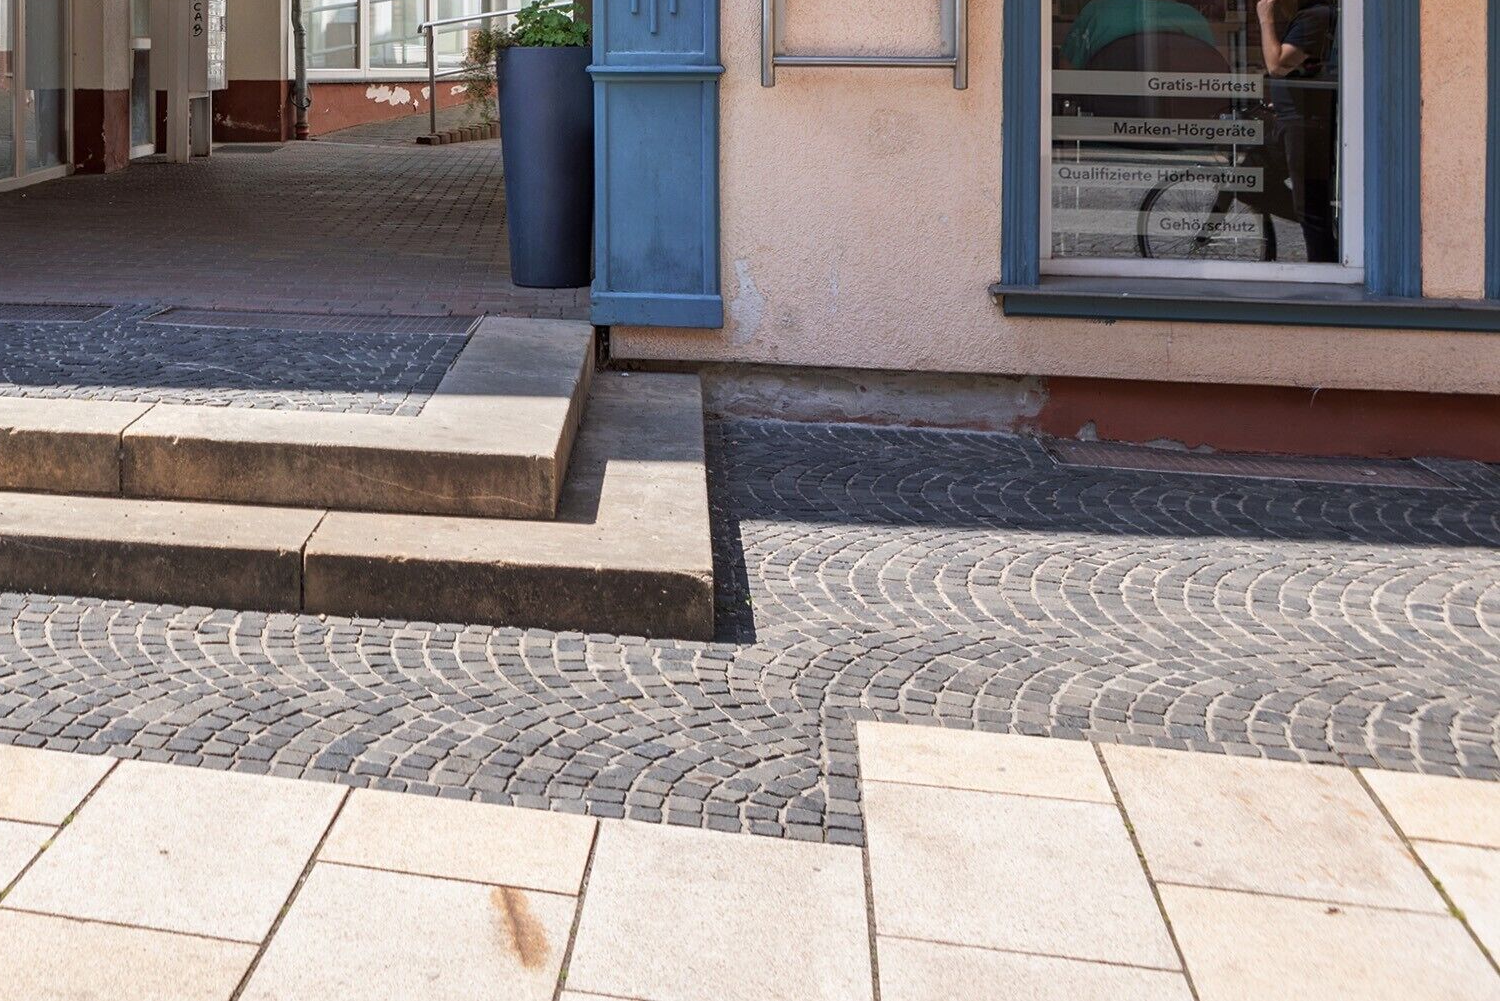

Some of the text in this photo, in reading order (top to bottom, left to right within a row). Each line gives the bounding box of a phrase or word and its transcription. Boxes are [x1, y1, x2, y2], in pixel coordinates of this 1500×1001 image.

[1148, 77, 1256, 93] Gratis-Hörtest
[1113, 121, 1256, 140] Marken-Hörgeräte
[1058, 167, 1257, 188] Qualifizierte Hörberatung
[1159, 217, 1256, 233] Gehörschutz
